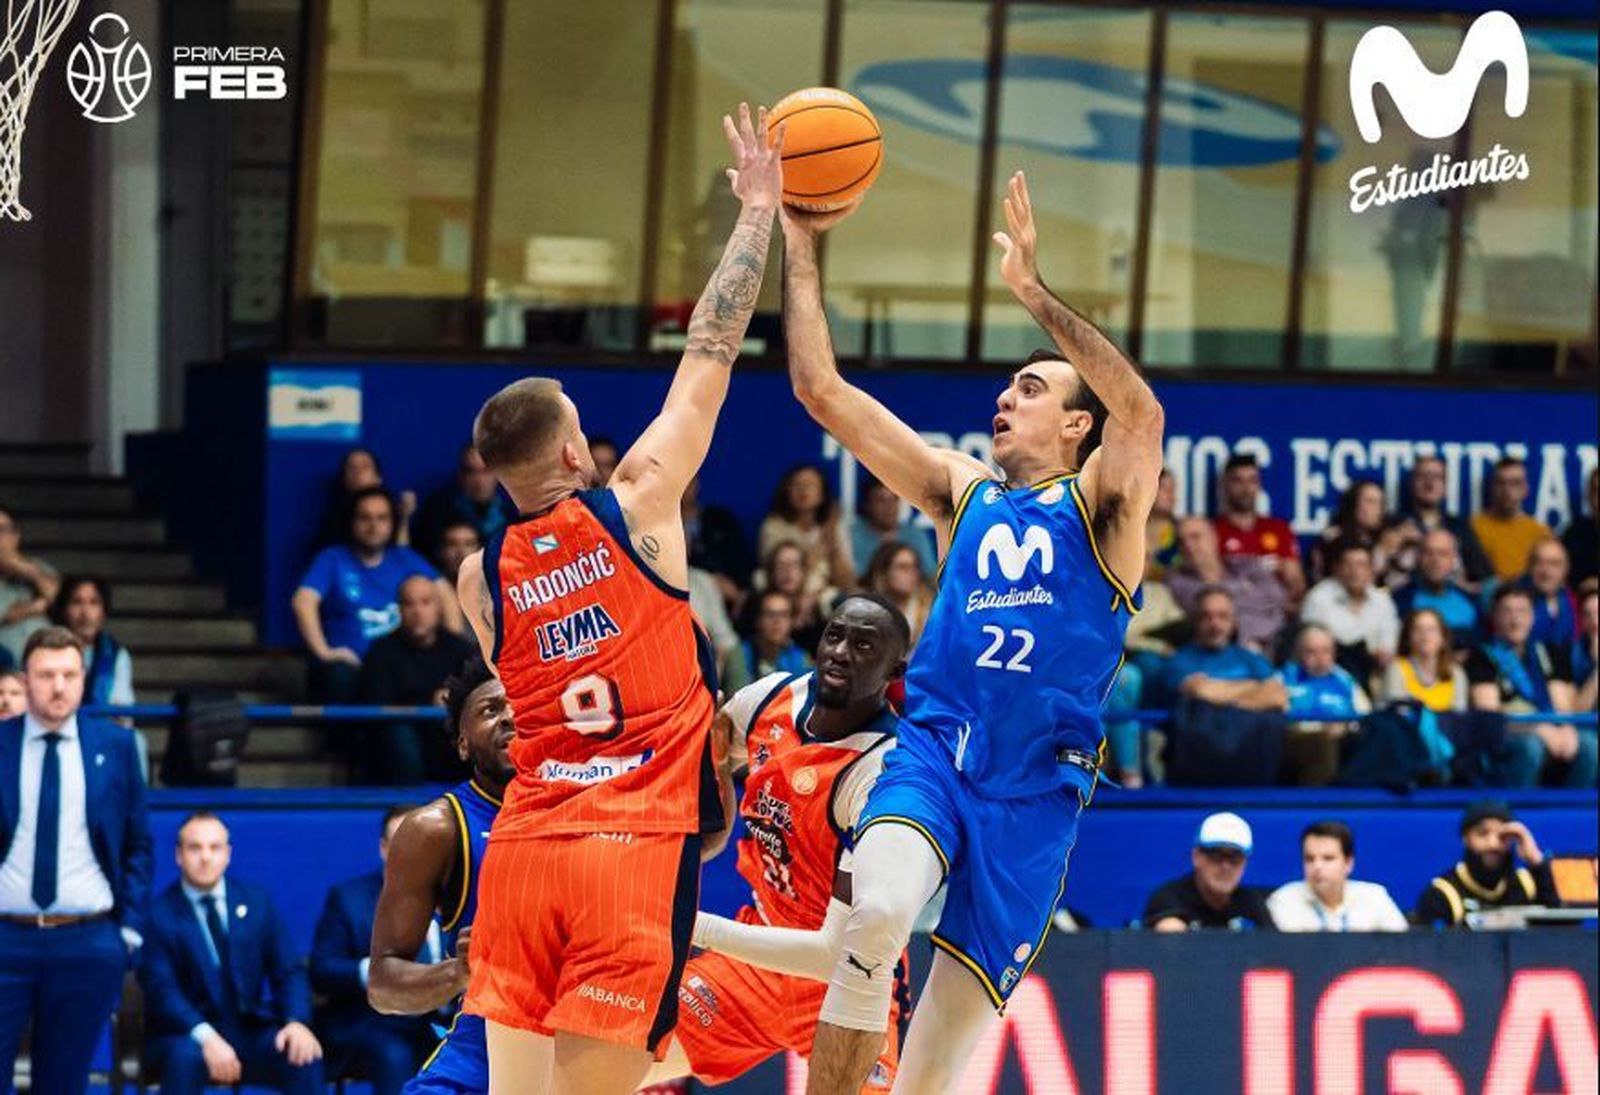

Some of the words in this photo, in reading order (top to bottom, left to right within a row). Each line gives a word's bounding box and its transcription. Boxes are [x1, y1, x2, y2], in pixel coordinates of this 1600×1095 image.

[508, 541, 616, 614] RADONČIĆ
[966, 583, 1054, 614] Estudiantes
[535, 603, 621, 662] LEYMA
[975, 625, 1036, 673] 22
[586, 984, 646, 1014] ABANCA
[786, 967, 1599, 1095] ALIGA
